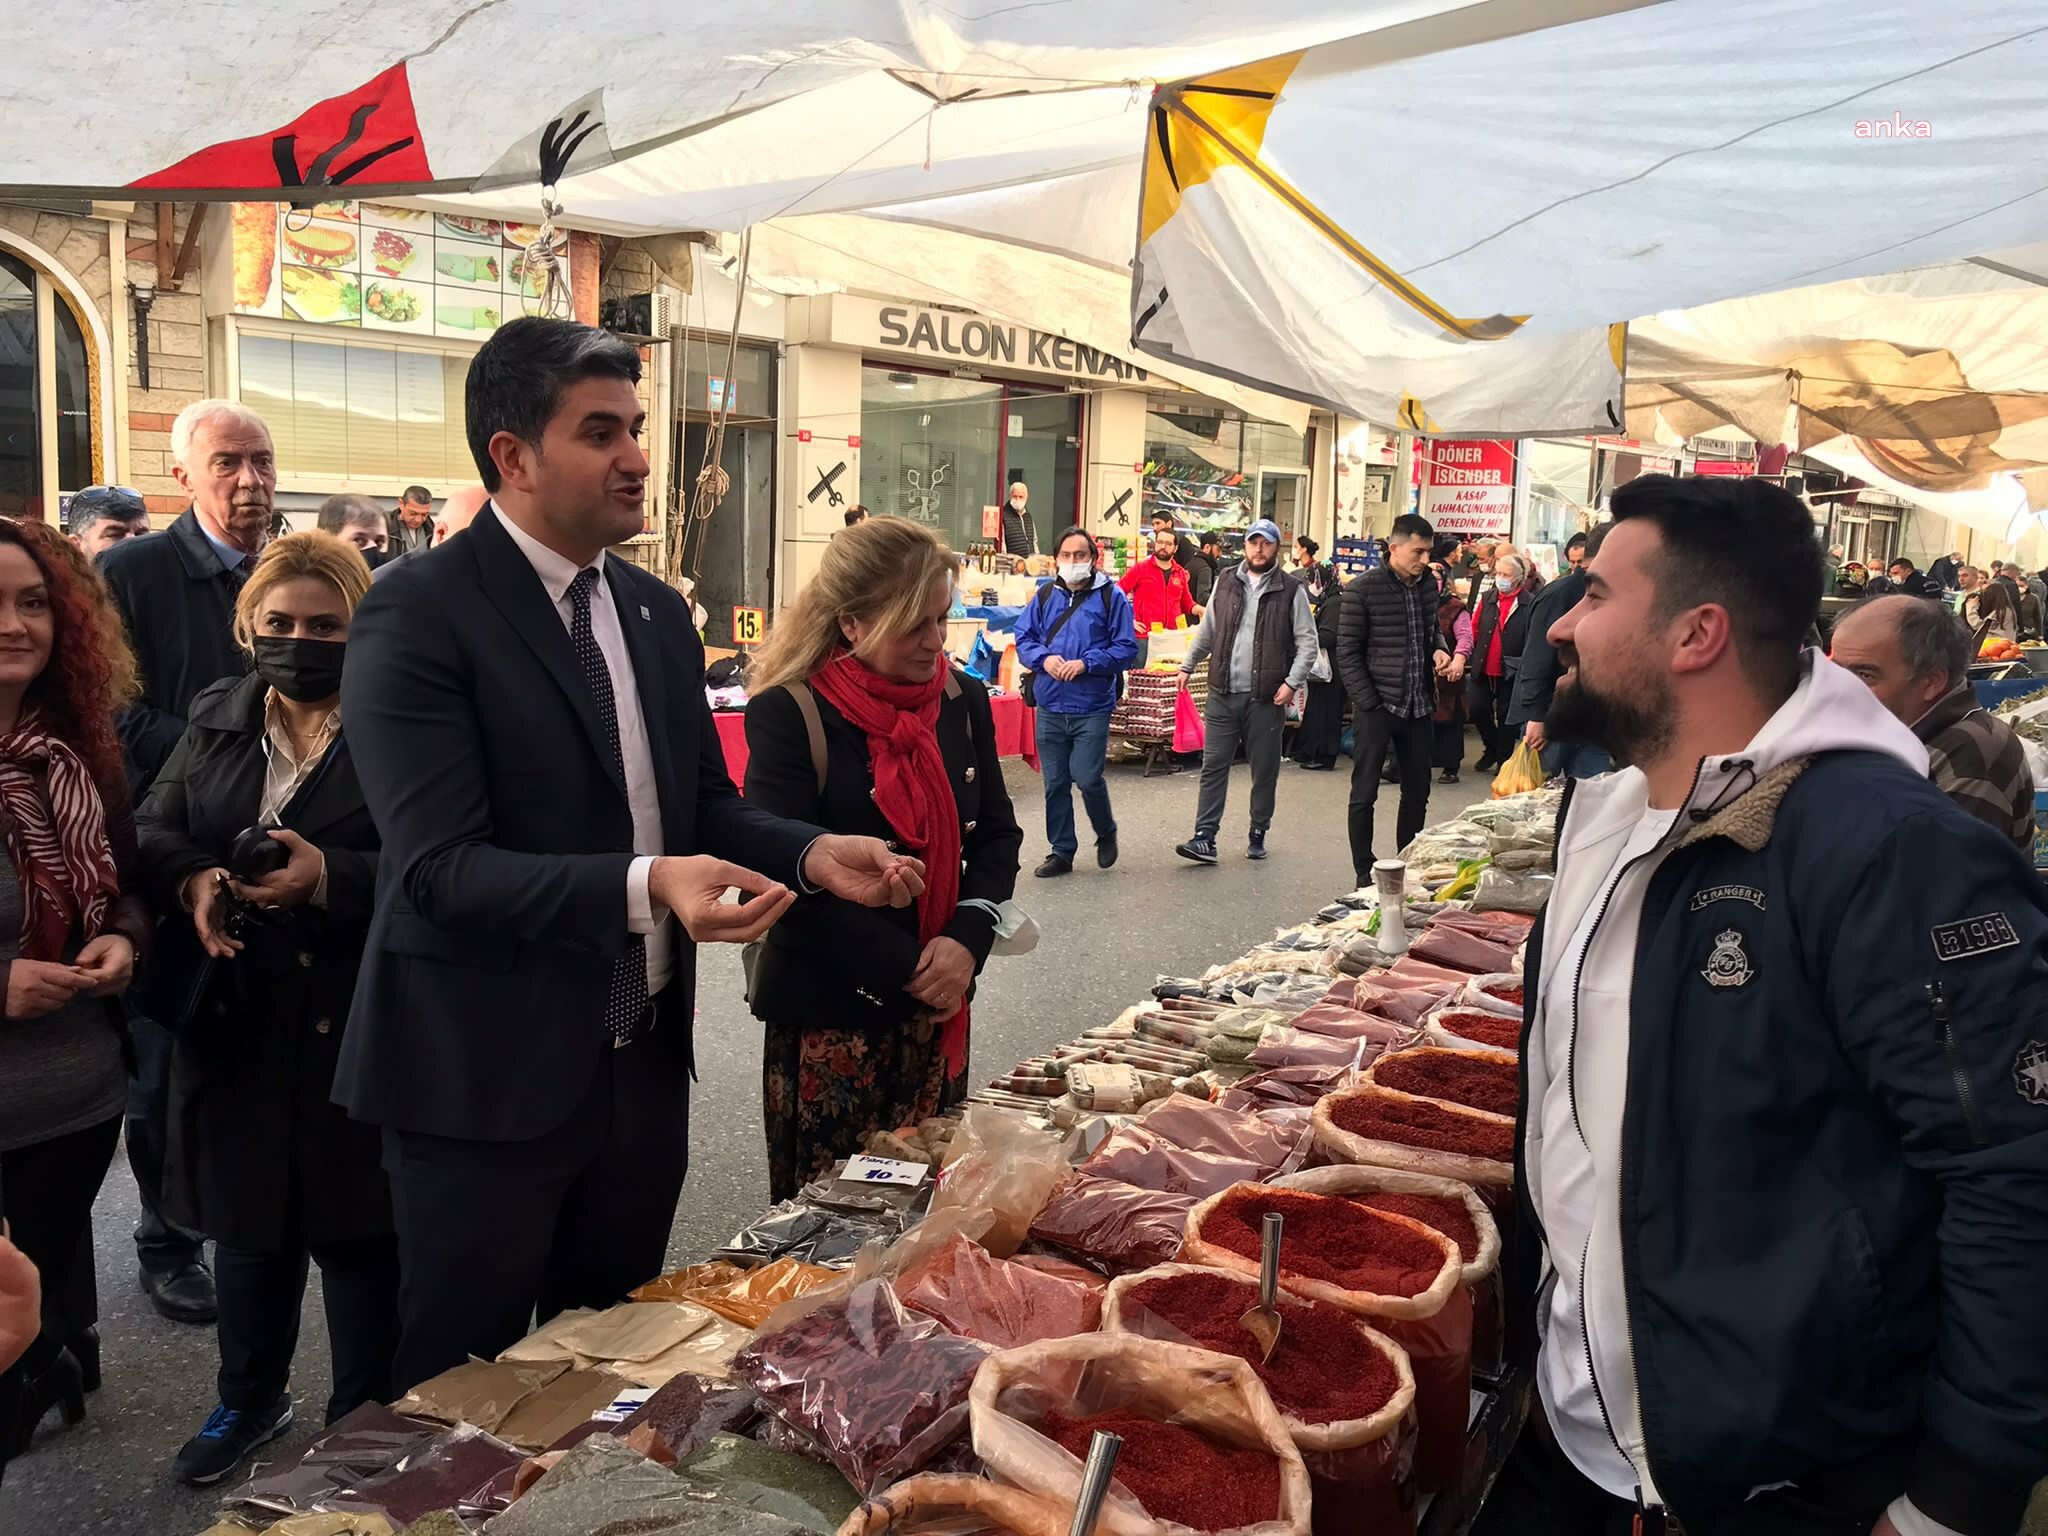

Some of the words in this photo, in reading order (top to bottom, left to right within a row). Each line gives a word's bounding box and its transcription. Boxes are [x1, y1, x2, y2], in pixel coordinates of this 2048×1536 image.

[879, 307, 1016, 362] SALON
[1437, 444, 1482, 463] DÖNER
[1435, 466, 1501, 485] İSKENDER
[1455, 491, 1487, 501] KASAP
[737, 611, 755, 639] 15
[1709, 887, 1753, 899] RANGER
[1940, 930, 1961, 954] EST
[865, 1169, 893, 1180] 10
